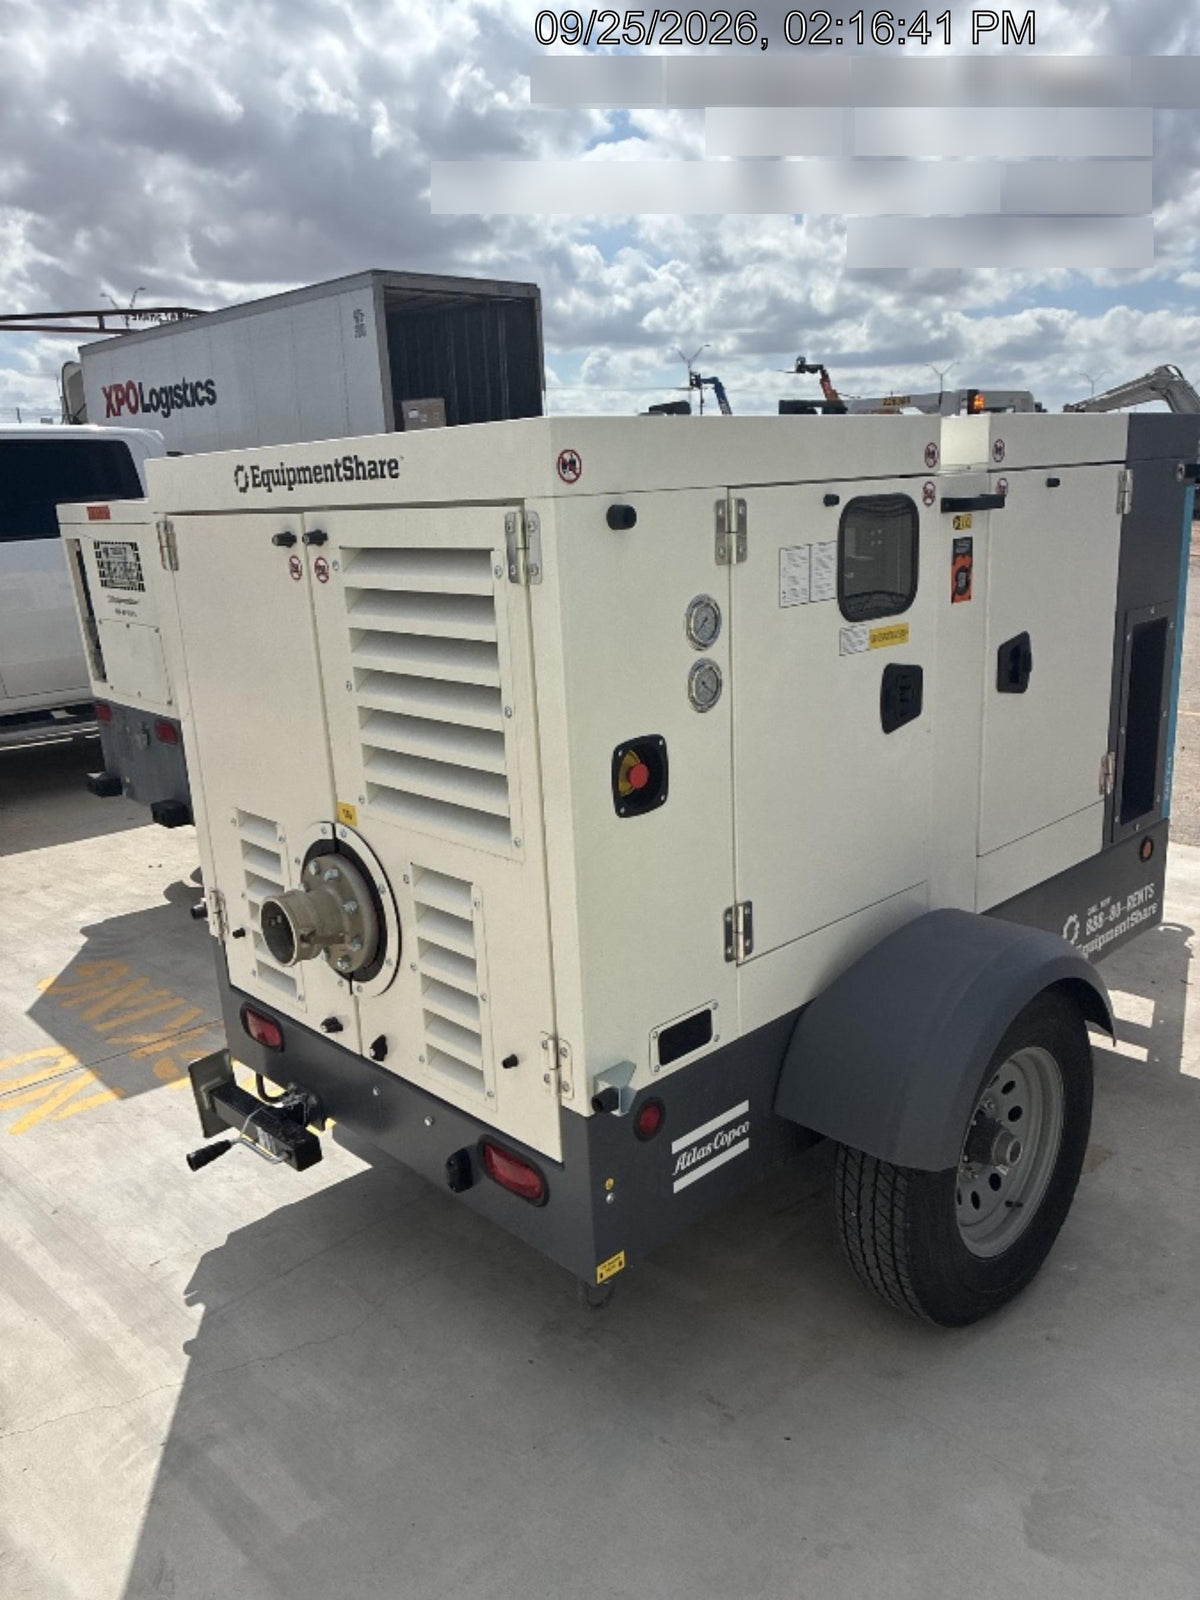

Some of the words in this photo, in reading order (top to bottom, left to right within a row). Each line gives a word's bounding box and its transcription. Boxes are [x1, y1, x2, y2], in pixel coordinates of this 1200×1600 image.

[250, 454, 400, 493] EquipmentShare
[1075, 902, 1158, 959] quipmentShare
[672, 1145, 713, 1176] Atlas
[713, 1120, 751, 1150] Copco
